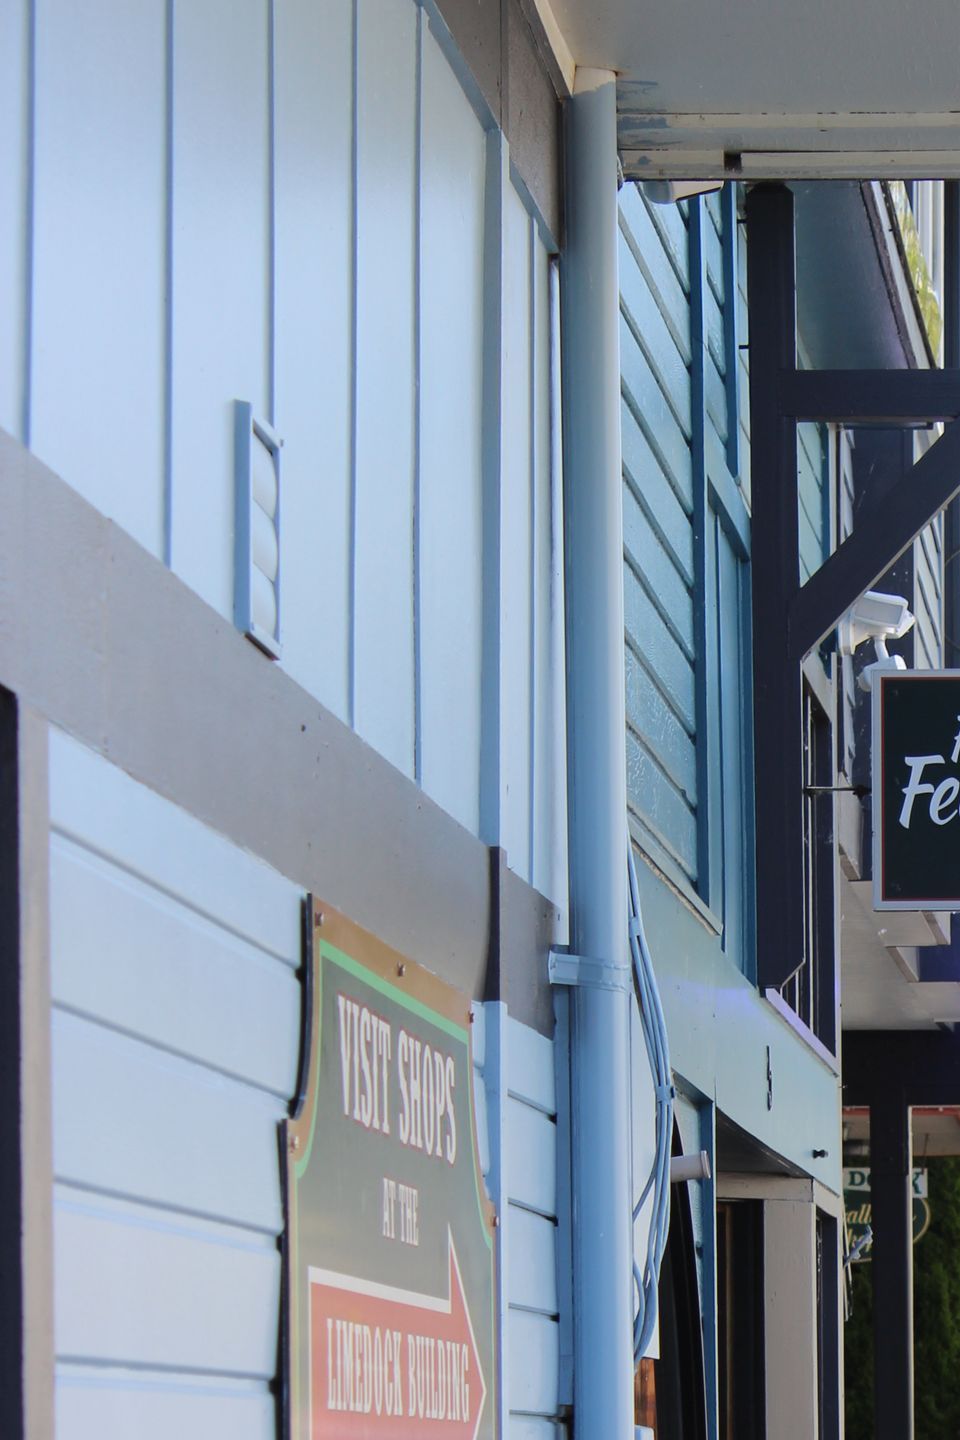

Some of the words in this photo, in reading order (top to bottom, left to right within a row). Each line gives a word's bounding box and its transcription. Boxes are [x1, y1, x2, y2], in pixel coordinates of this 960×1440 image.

[337, 994, 391, 1135] VISIT
[398, 1029, 456, 1165] SHOPS
[382, 1177, 396, 1239] AT
[398, 1183, 419, 1246] THE
[326, 1318, 403, 1417] LIMEDOCK
[407, 1333, 470, 1424] BUILDING
